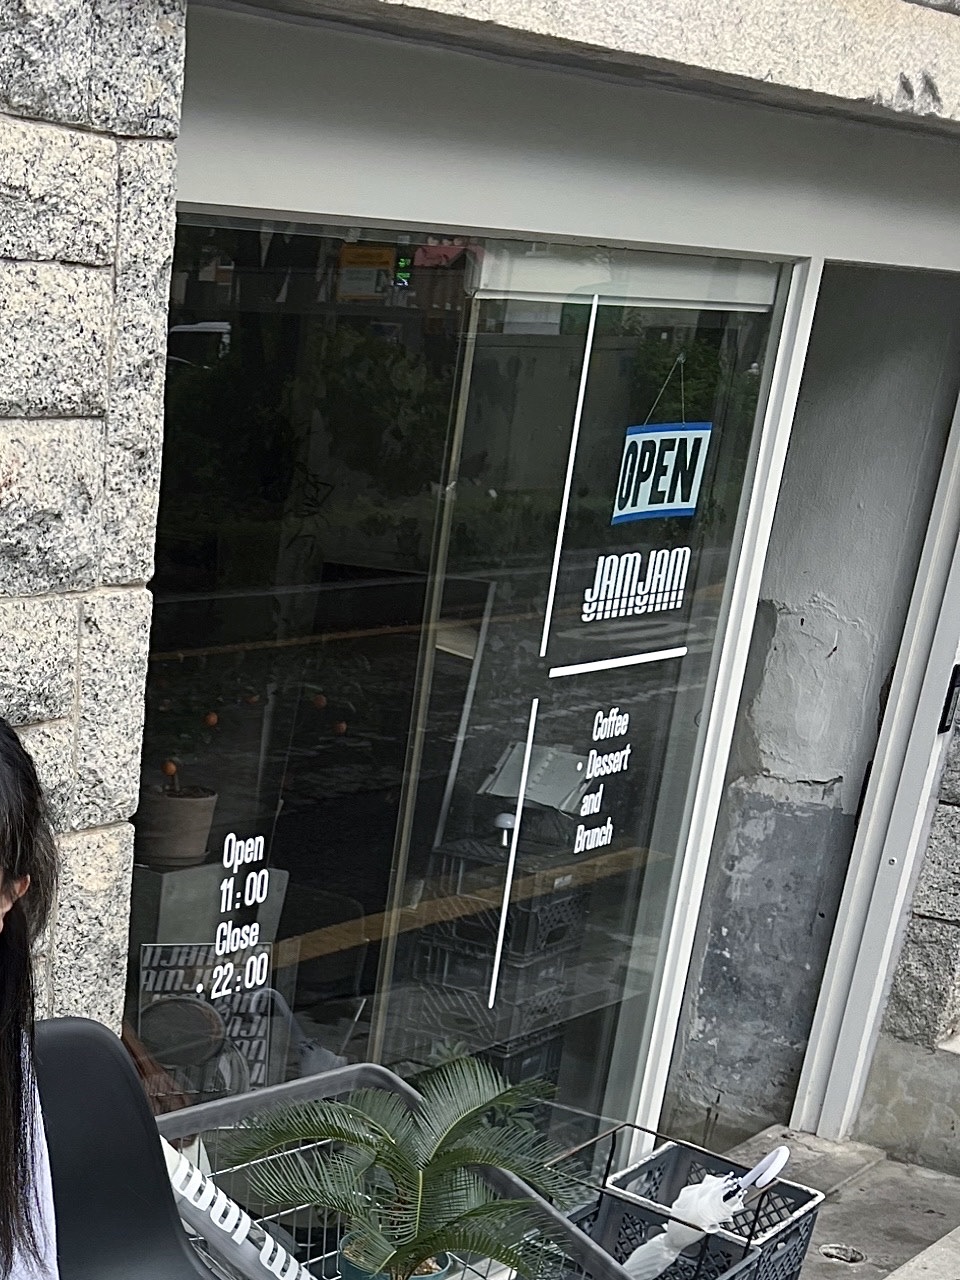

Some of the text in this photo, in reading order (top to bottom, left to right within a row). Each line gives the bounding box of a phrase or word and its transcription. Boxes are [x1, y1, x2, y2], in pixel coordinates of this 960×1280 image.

[617, 437, 703, 511] OPEN
[592, 707, 629, 741] Coffee
[586, 743, 631, 779] Dessert
[580, 783, 604, 816] and
[222, 832, 265, 873] Open
[573, 816, 613, 854] Brunch
[220, 868, 269, 913] 11:00
[215, 922, 260, 956] Close
[211, 952, 268, 999] 22:00
